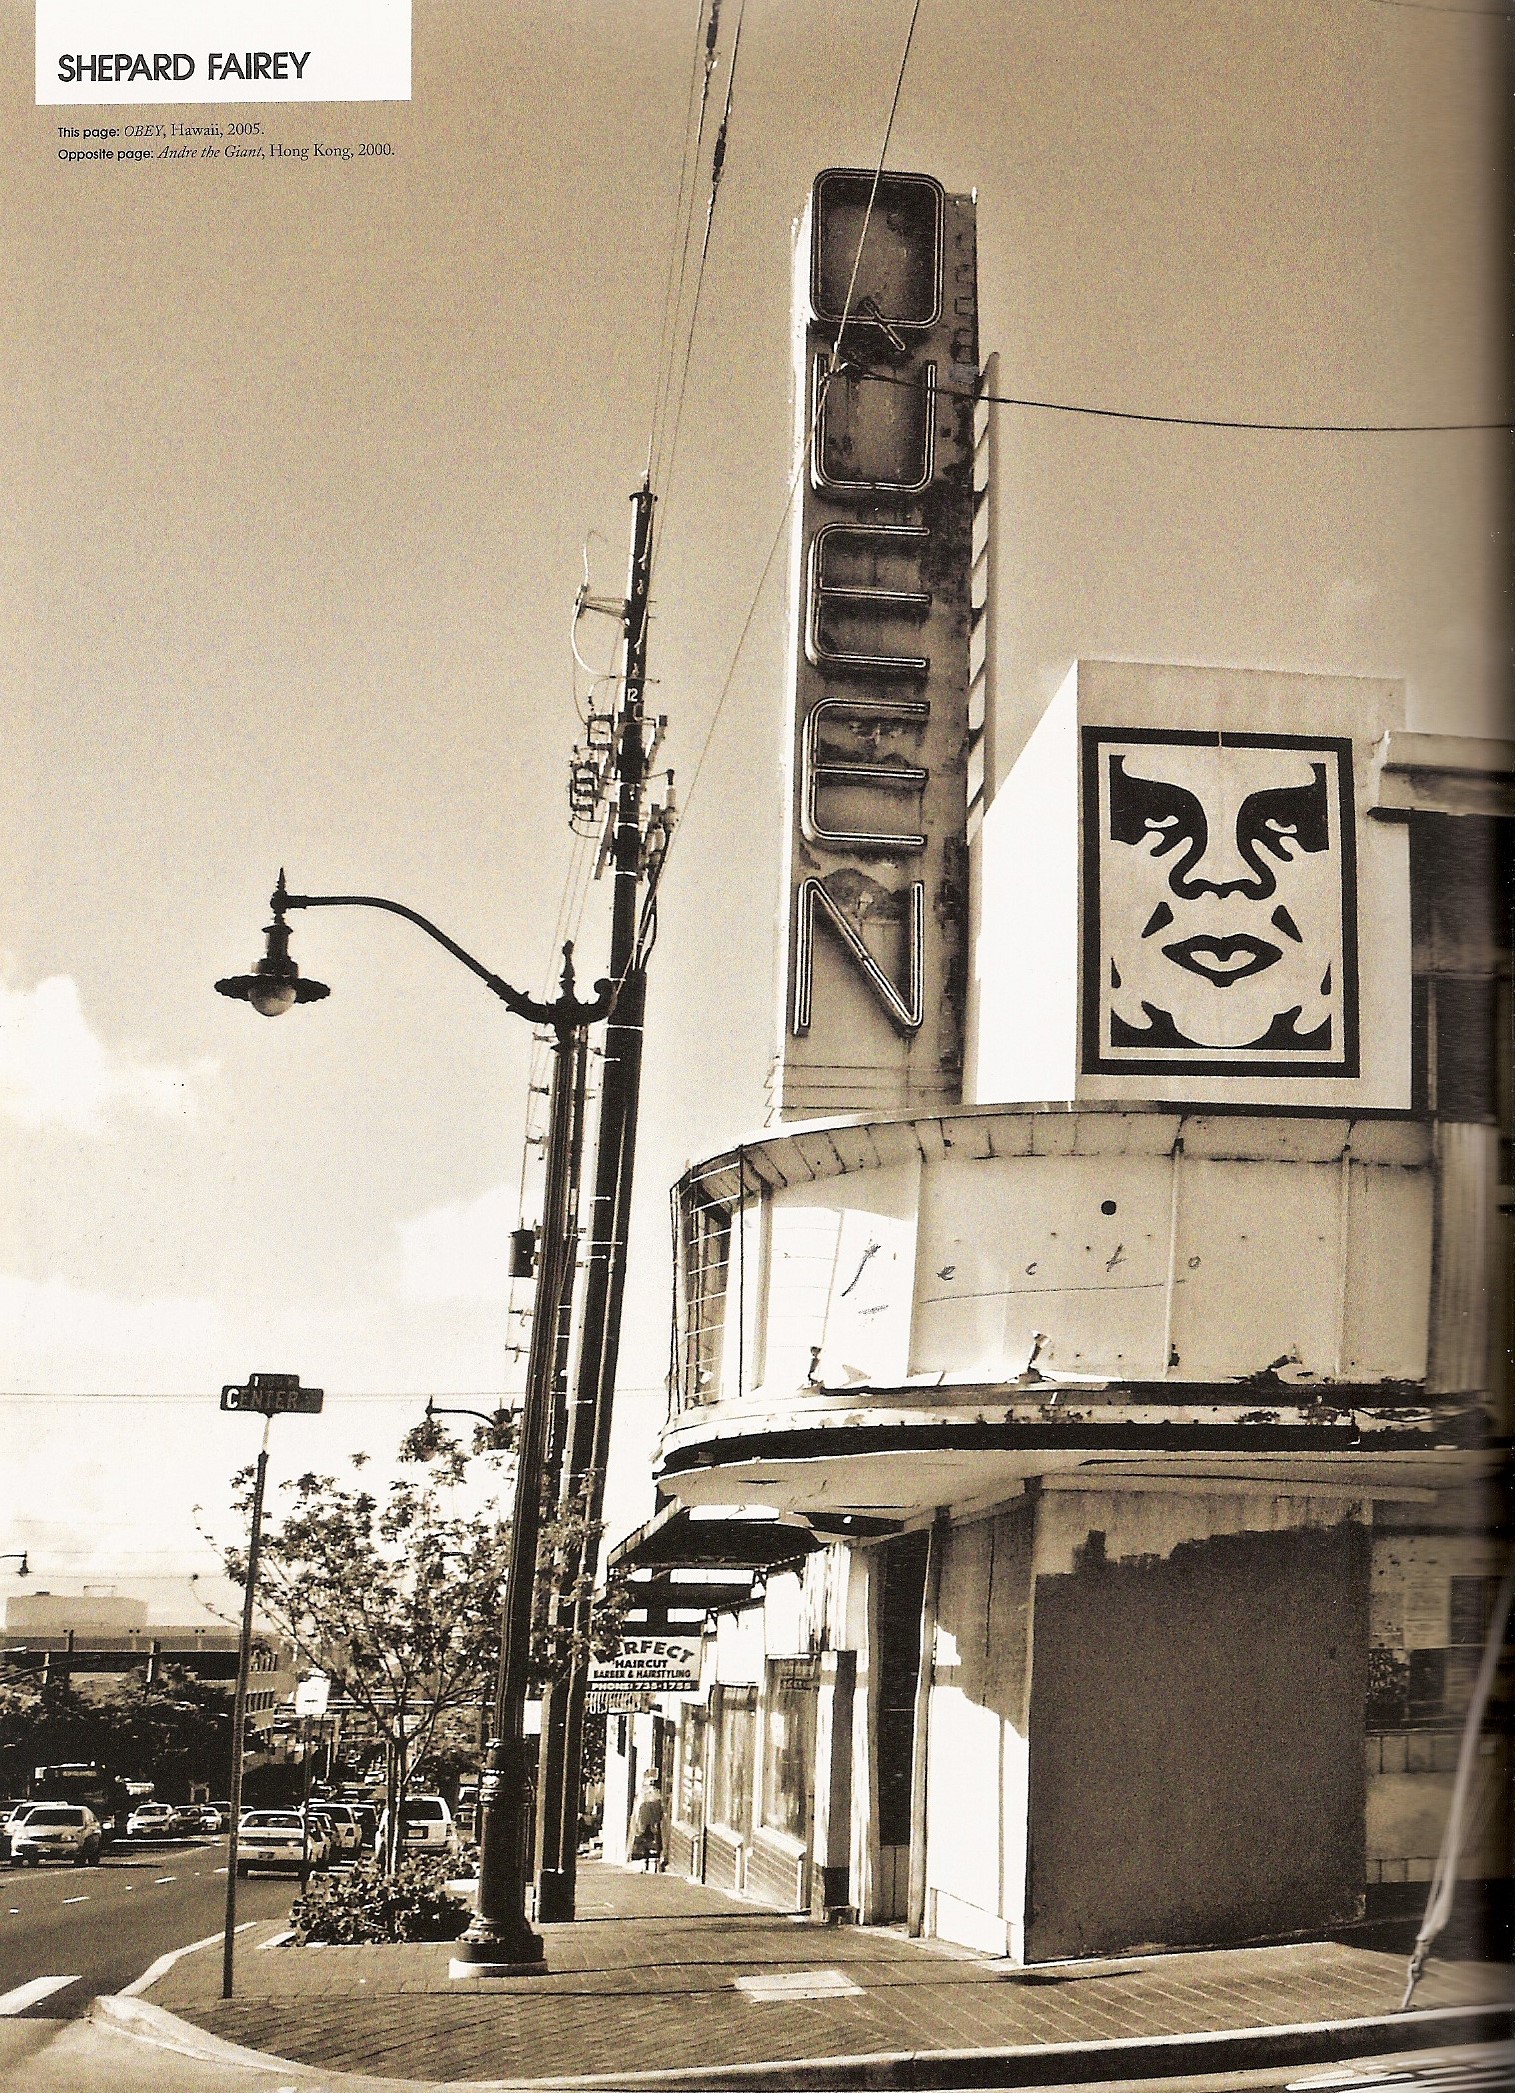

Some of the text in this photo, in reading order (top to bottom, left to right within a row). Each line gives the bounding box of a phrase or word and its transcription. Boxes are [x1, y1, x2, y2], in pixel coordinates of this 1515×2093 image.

[793, 168, 946, 1037] QUEEN
[627, 687, 639, 702] 12
[615, 1659, 669, 1669] HAIRCUT
[627, 1670, 635, 1679] &
[636, 1669, 691, 1679] HAIRSTYLING
